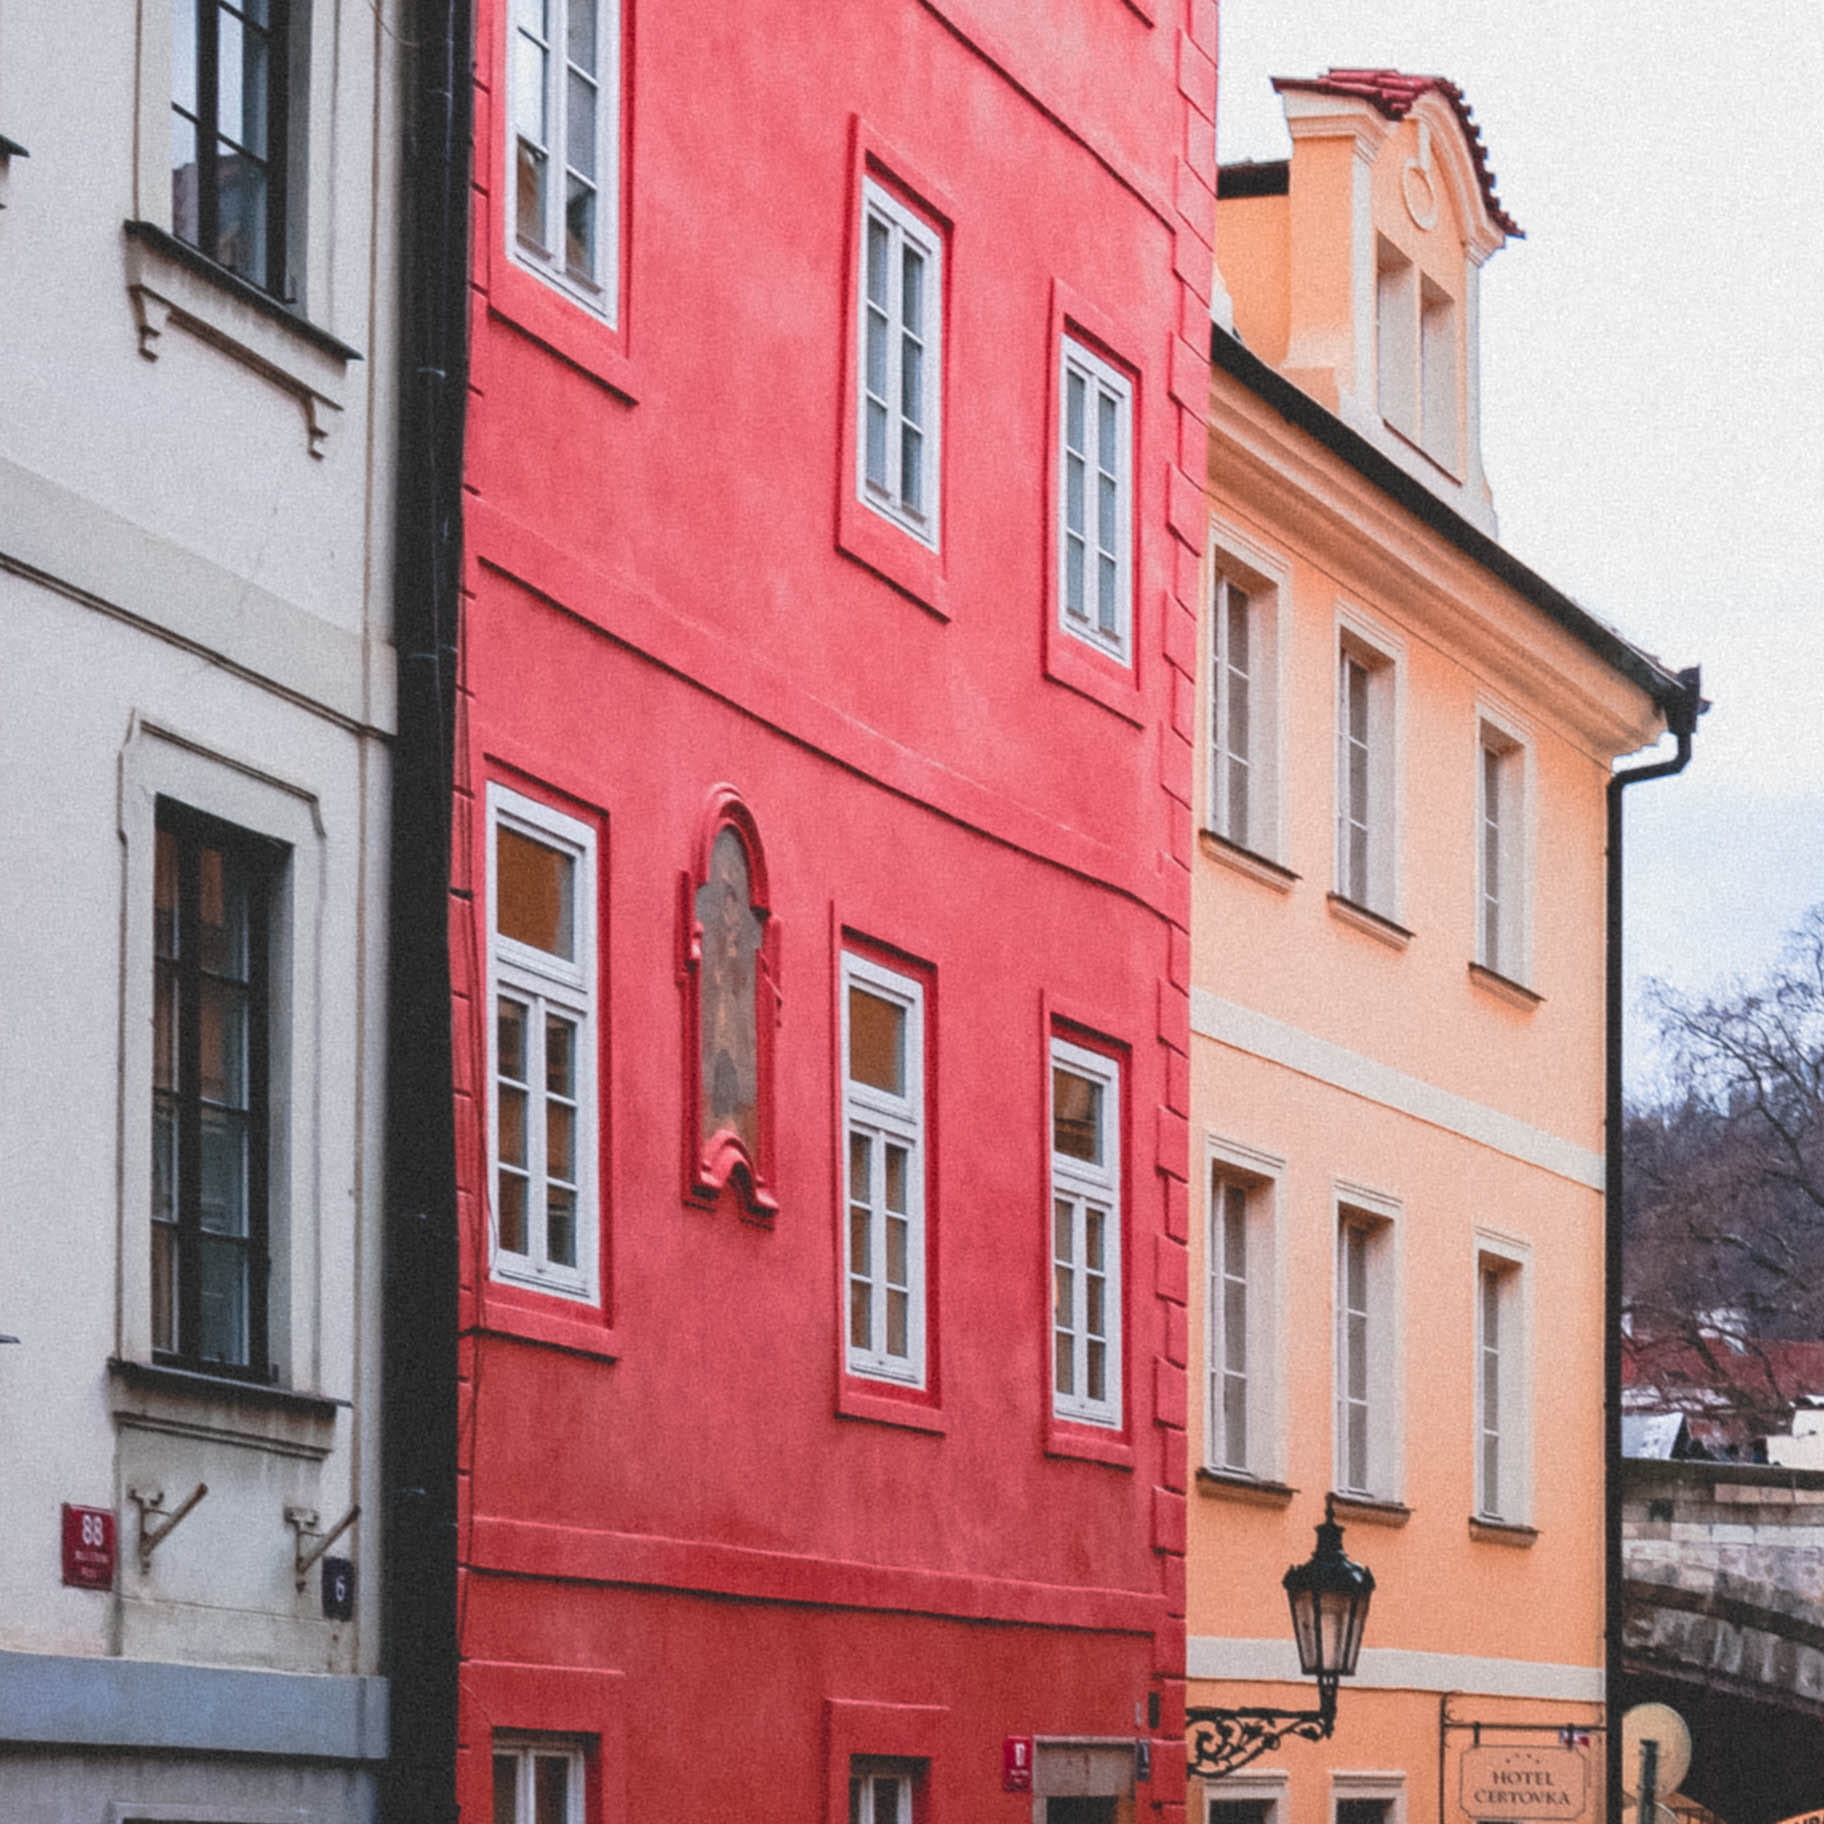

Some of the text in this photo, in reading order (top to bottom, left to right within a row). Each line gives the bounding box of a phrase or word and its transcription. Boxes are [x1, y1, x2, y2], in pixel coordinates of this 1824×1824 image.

[82, 1514, 104, 1546] 88
[335, 1575, 345, 1602] 6
[1492, 1771, 1555, 1786] HOTEL
